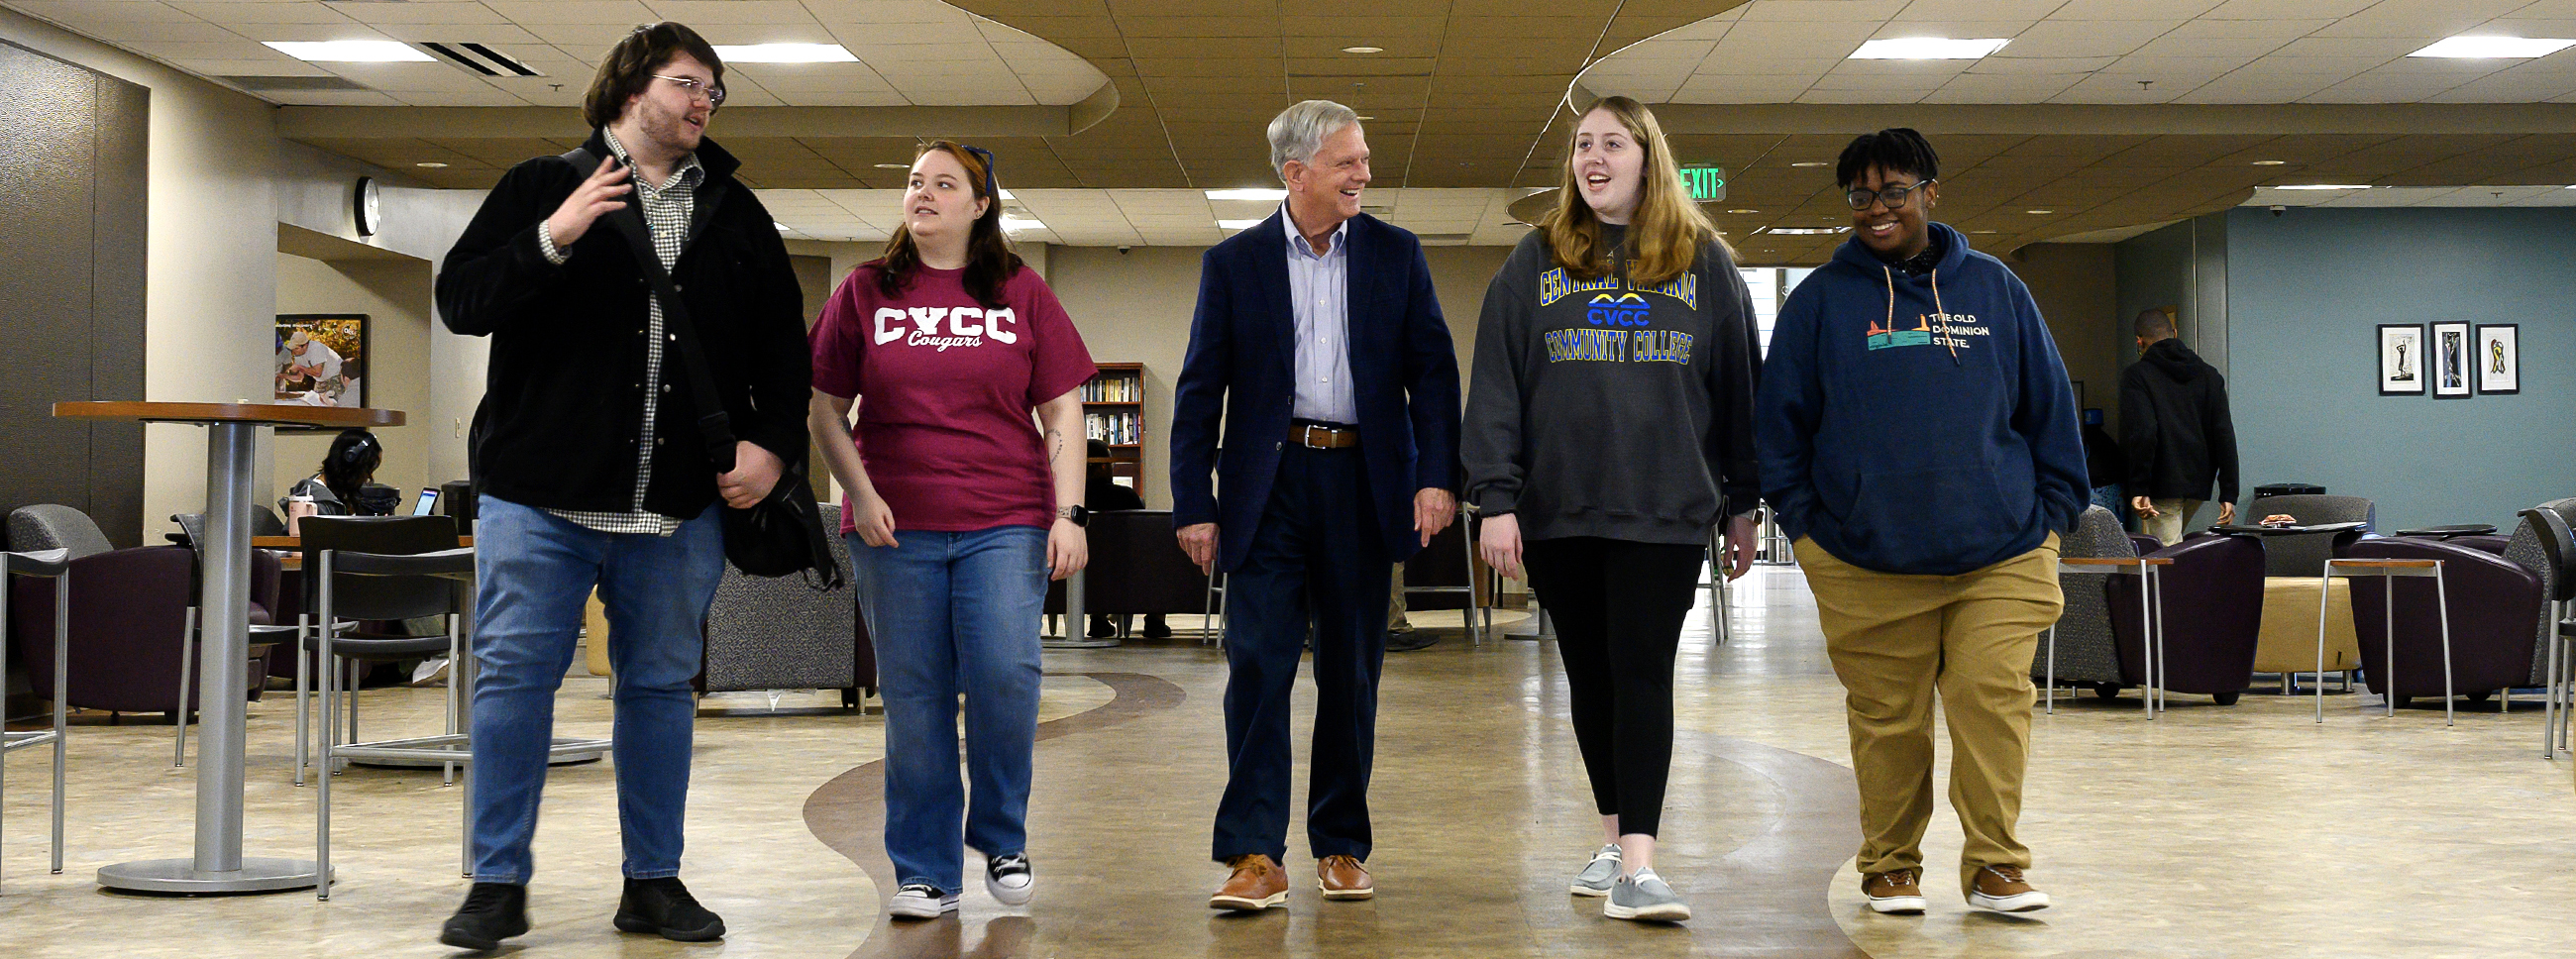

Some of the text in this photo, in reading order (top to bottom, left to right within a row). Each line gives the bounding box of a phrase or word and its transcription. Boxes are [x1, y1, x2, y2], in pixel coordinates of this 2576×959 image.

[1679, 168, 1719, 199] EXIT
[1587, 308, 1650, 327] CVCC
[1928, 313, 1976, 323] THE OLD
[1932, 325, 1989, 336] DOMINION
[908, 330, 983, 353] Cougars
[1545, 328, 1694, 366] COMMUNITY COLLEGE
